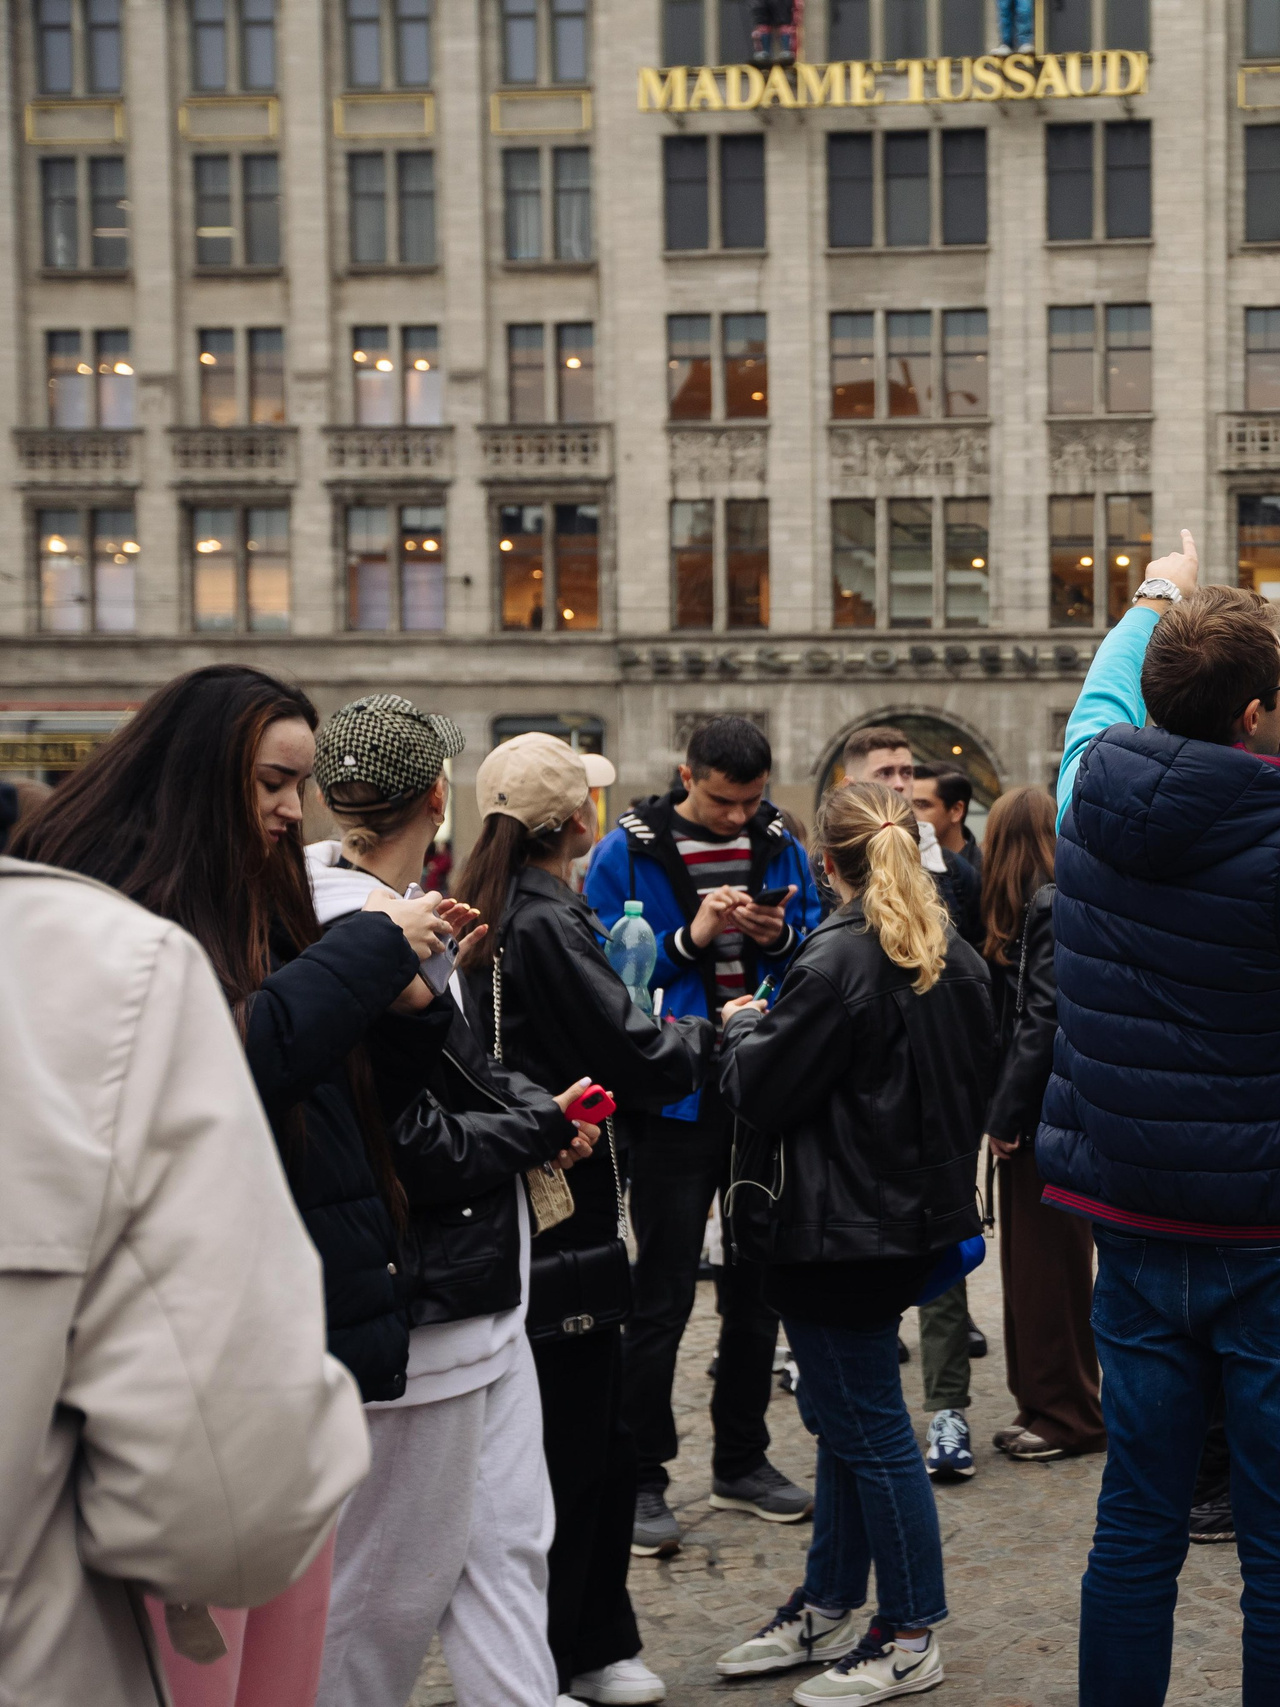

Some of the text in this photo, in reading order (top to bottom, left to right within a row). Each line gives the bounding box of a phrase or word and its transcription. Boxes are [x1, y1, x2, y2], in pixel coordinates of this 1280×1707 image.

[637, 50, 1147, 112] MADAME TUSSAUD
[800, 643, 1099, 675] CLOPPENB
